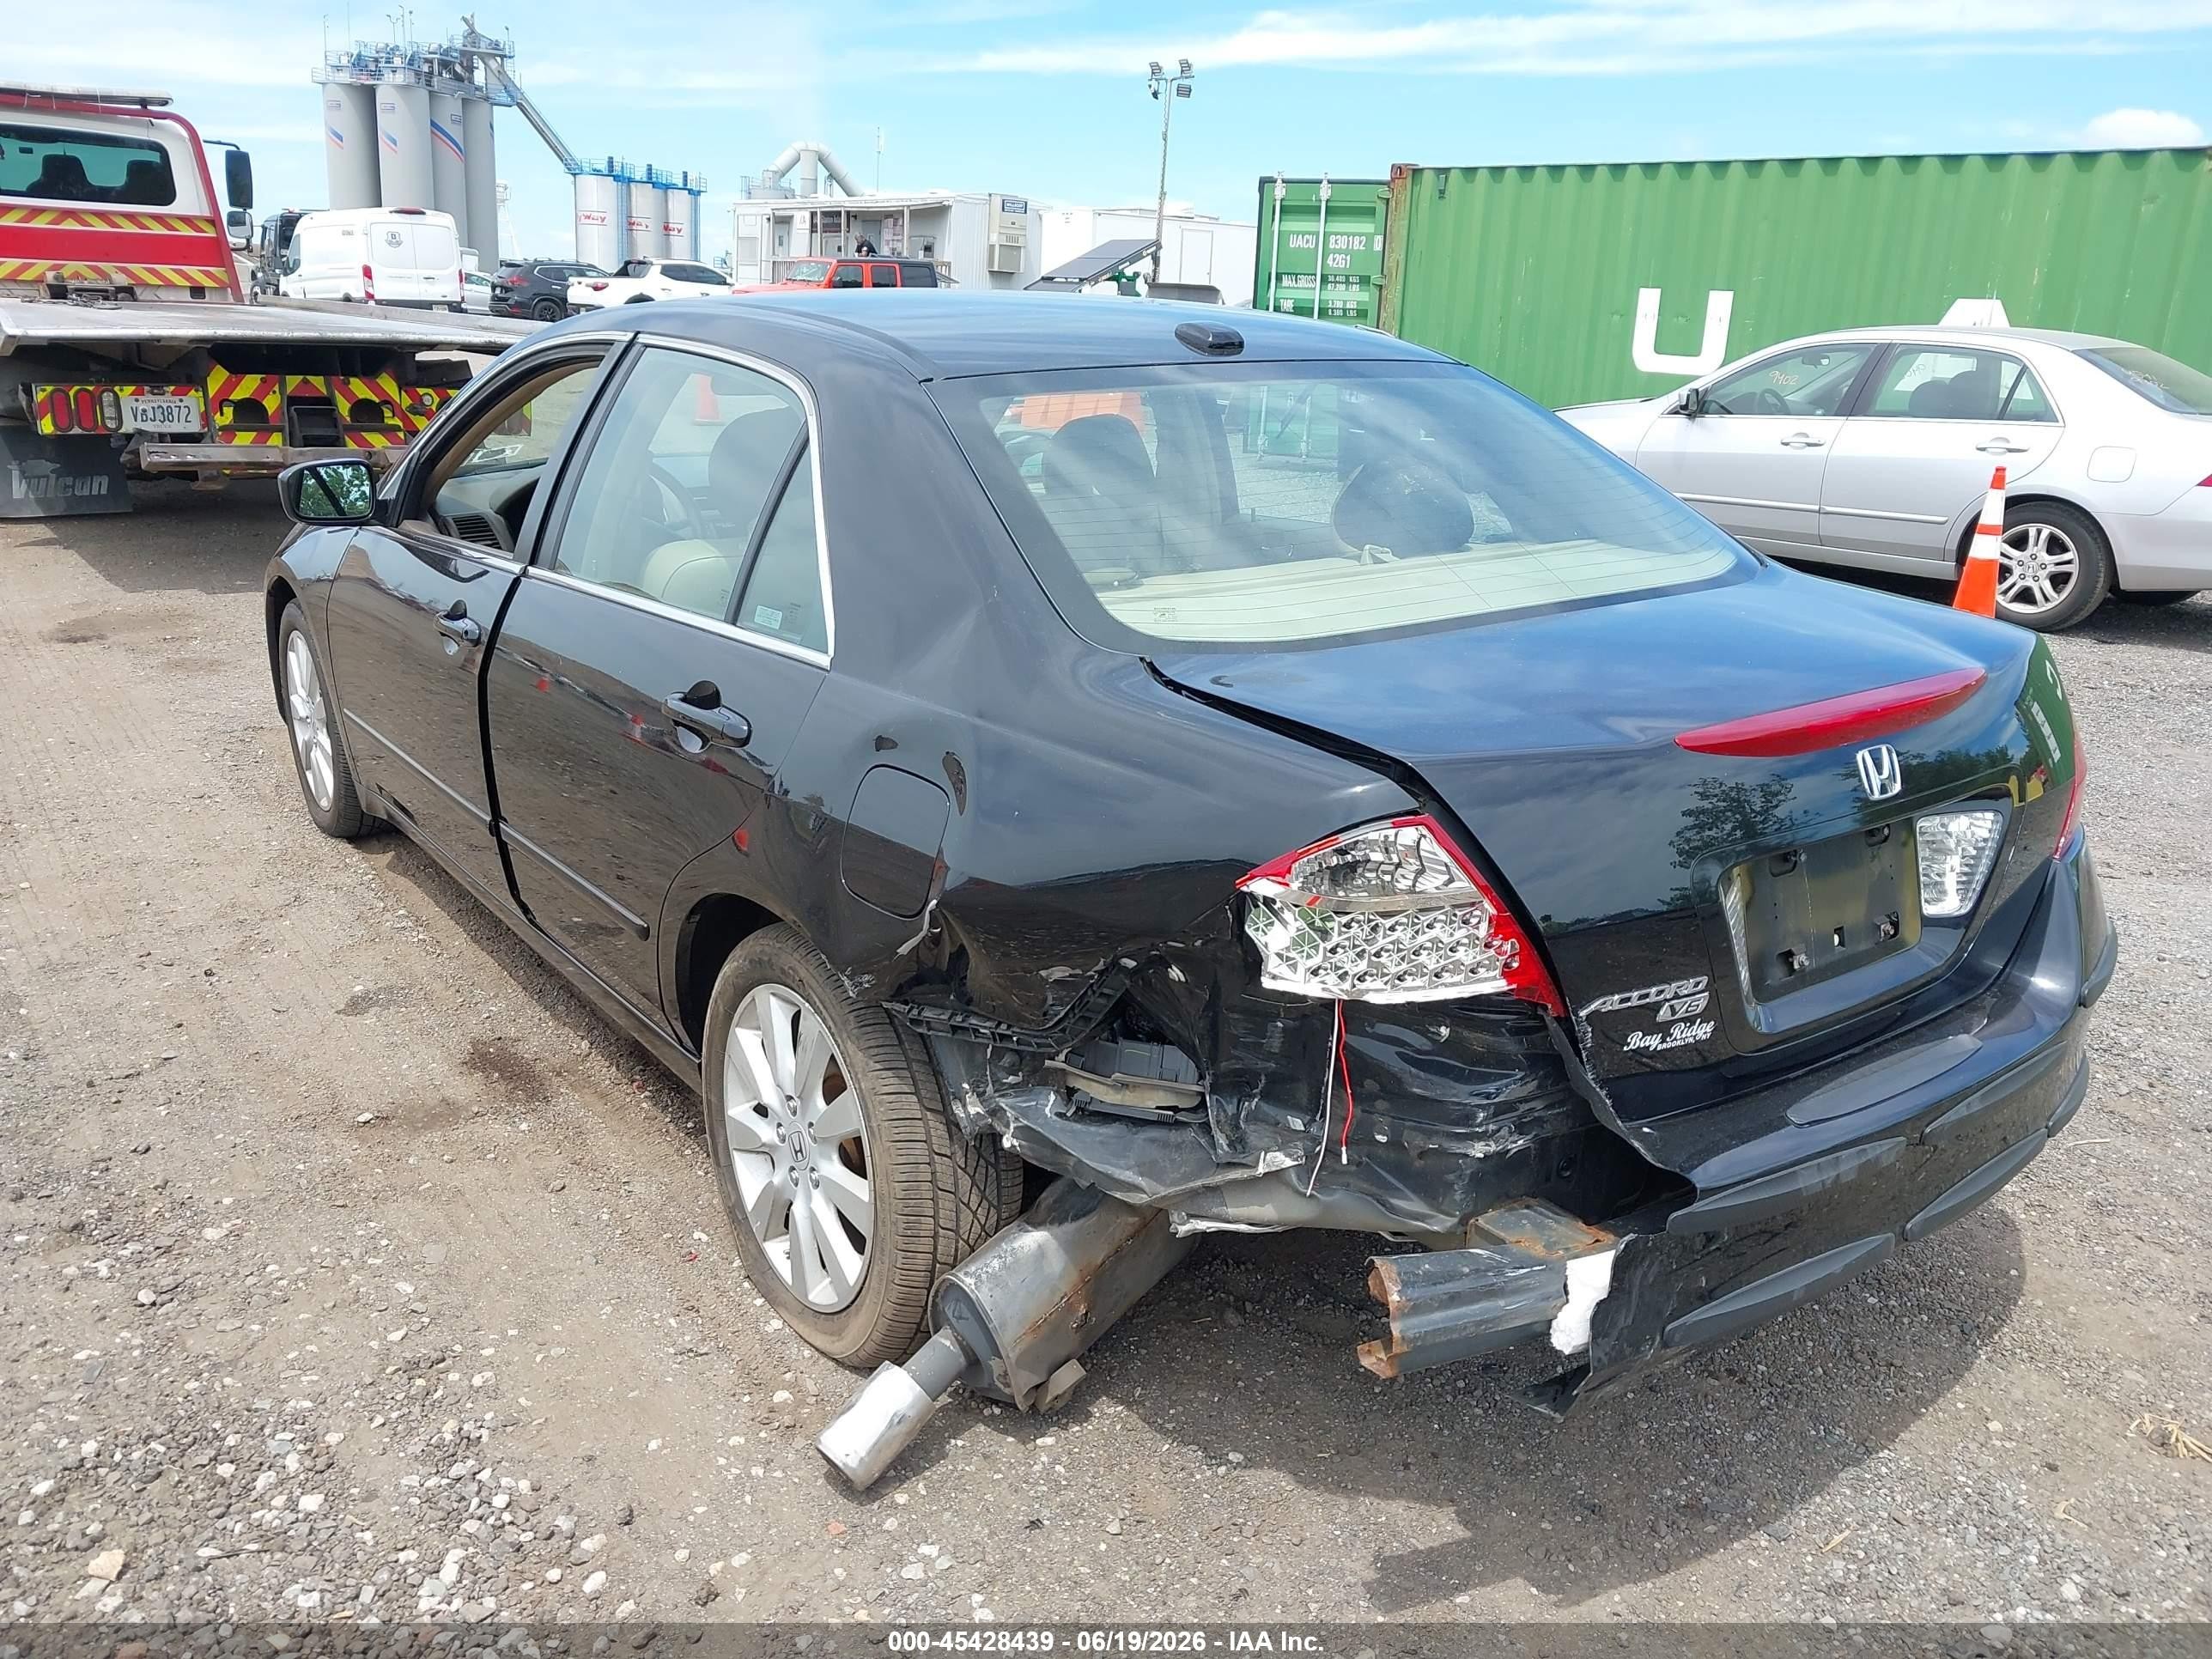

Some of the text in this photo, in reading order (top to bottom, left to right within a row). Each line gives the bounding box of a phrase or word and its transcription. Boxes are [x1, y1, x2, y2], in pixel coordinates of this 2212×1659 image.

[1289, 234, 1316, 248] UACU
[1328, 234, 1366, 250] 830182
[1327, 253, 1351, 268] 42G1
[1279, 299, 1295, 312] TARE
[1769, 370, 1800, 386] 9402
[131, 404, 191, 423] VBJ3872
[12, 469, 109, 498] Vulcan
[1578, 975, 1709, 1016] ACCORD
[1656, 992, 1710, 1022] V6
[1623, 1018, 1716, 1051] Bay Ridge
[1656, 1032, 1711, 1051] BROOKLYN, NY
